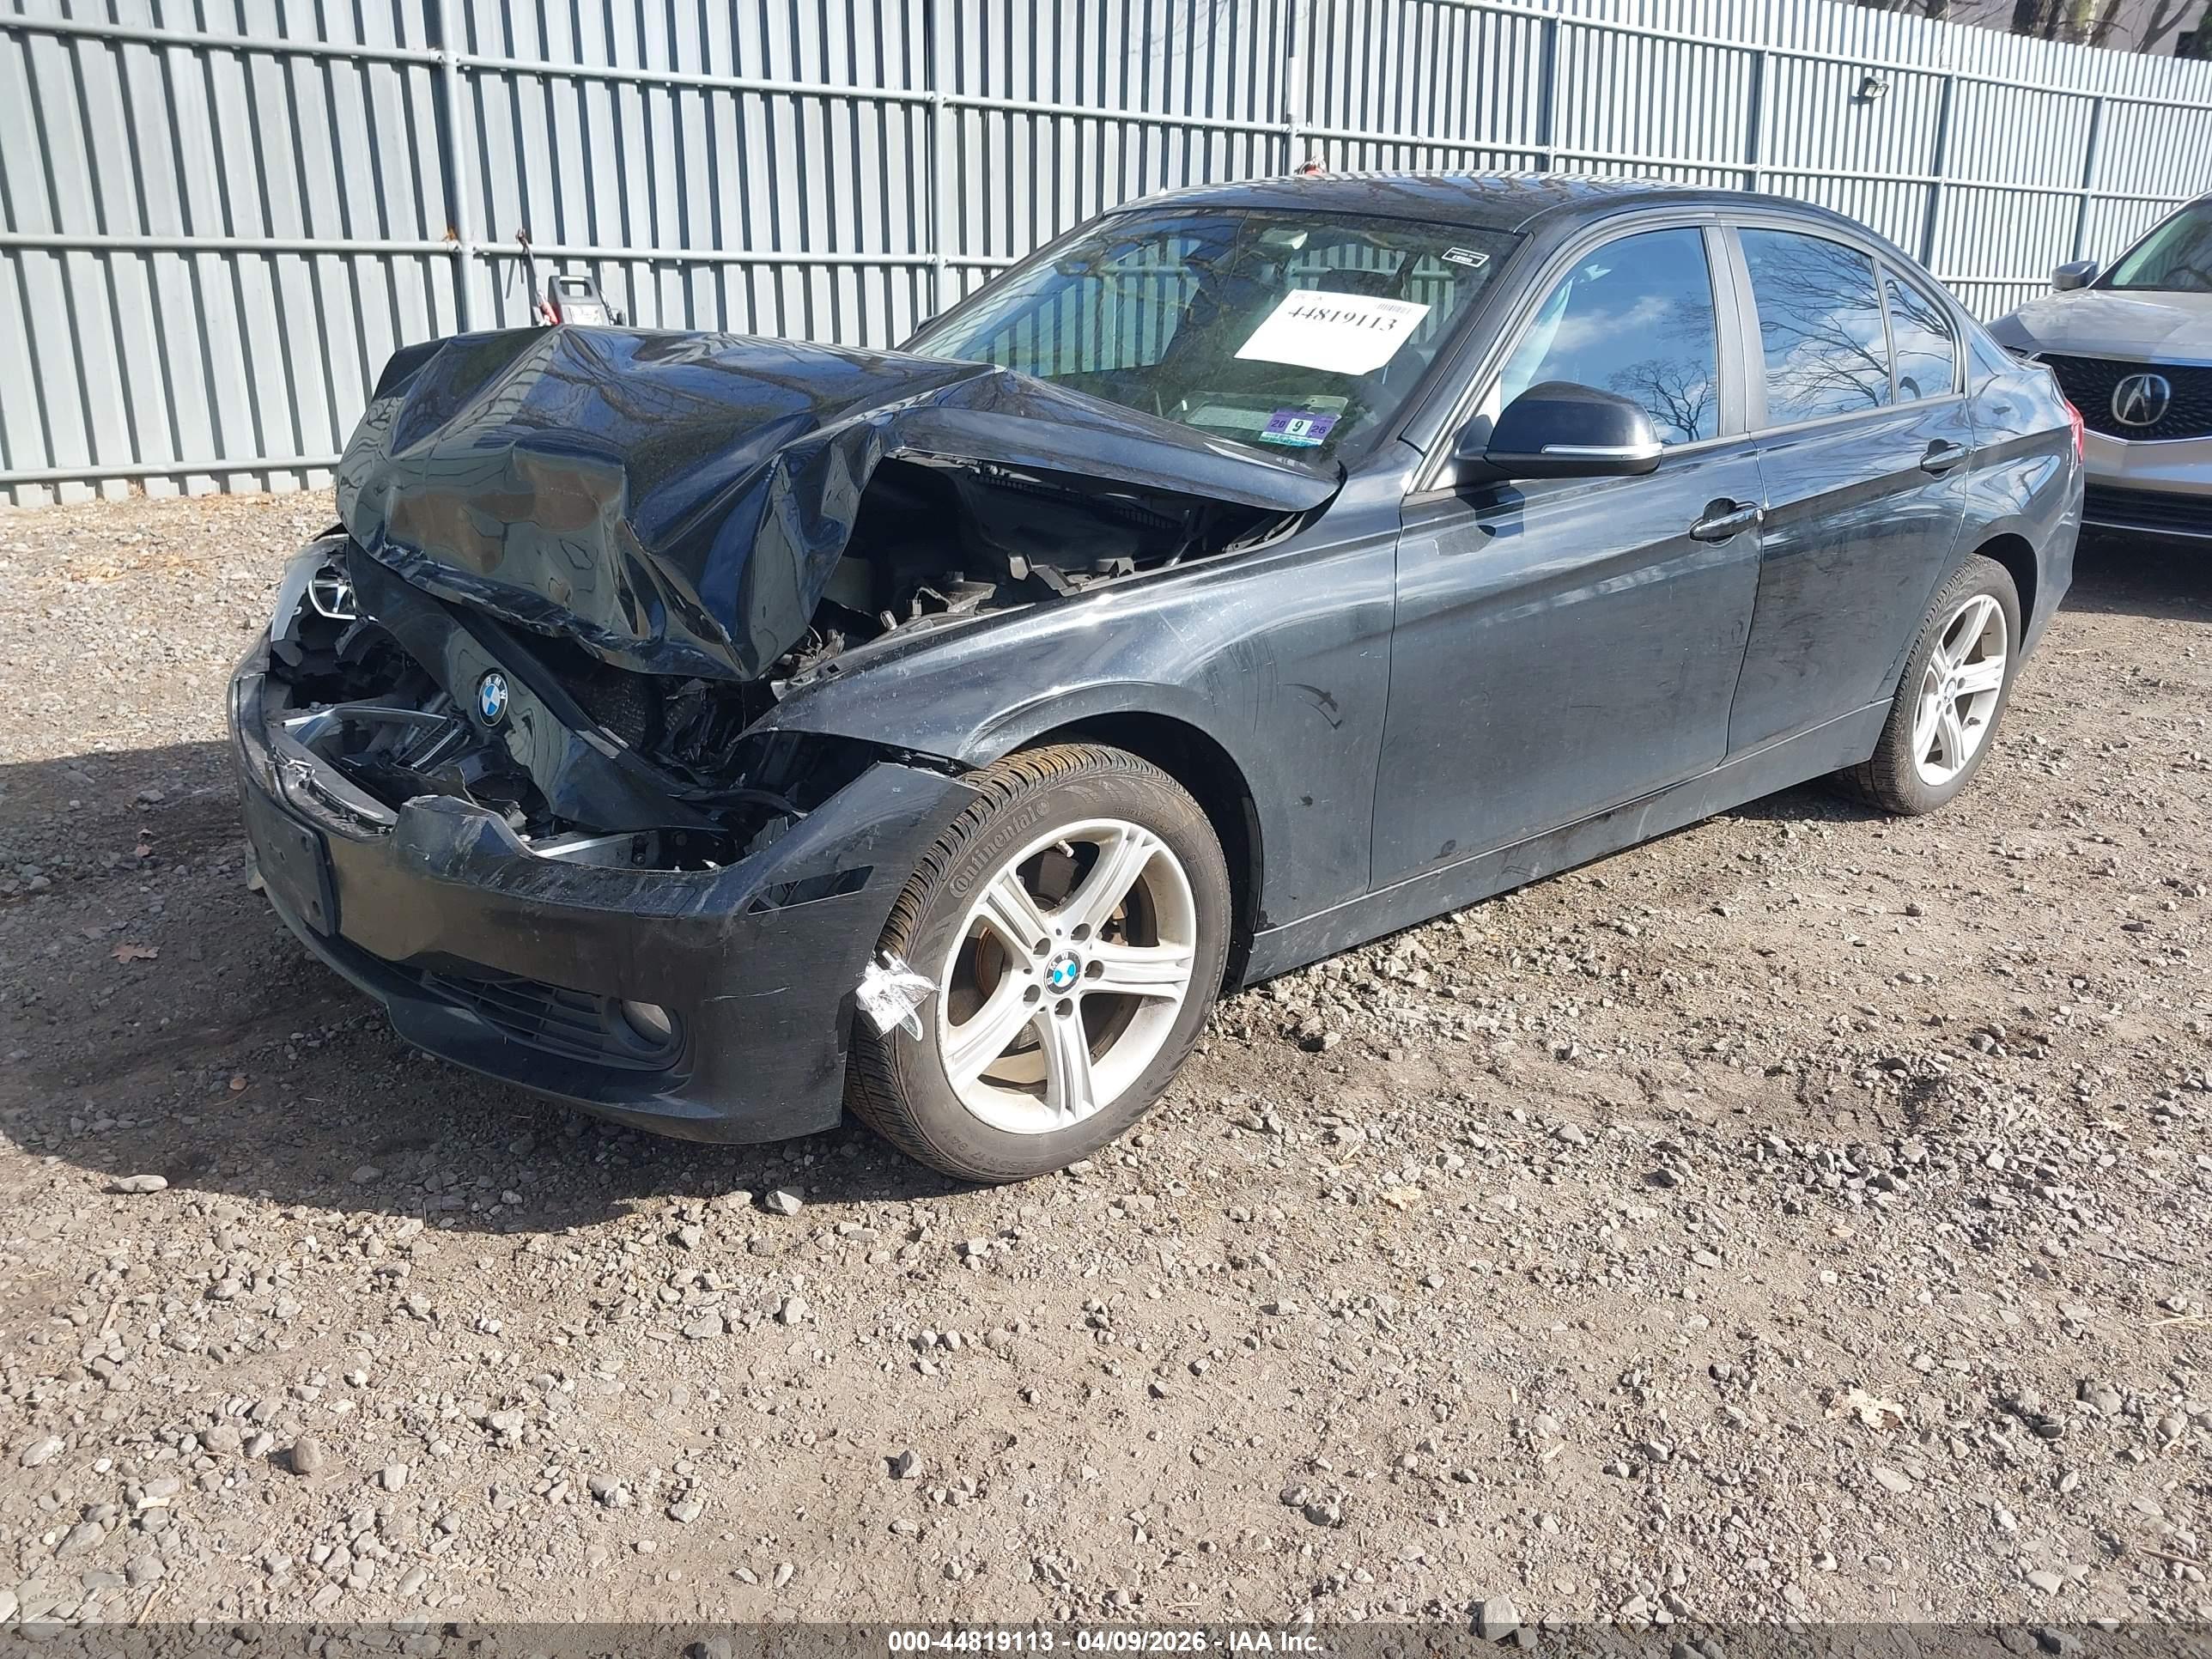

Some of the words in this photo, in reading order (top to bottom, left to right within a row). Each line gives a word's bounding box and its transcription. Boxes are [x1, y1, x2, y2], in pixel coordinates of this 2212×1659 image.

[1287, 305, 1398, 331] 44819113
[1271, 419, 1286, 428] 20
[1291, 420, 1304, 432] 9
[1310, 425, 1327, 434] 26
[484, 676, 507, 700] BMW
[949, 805, 1038, 898] Continental
